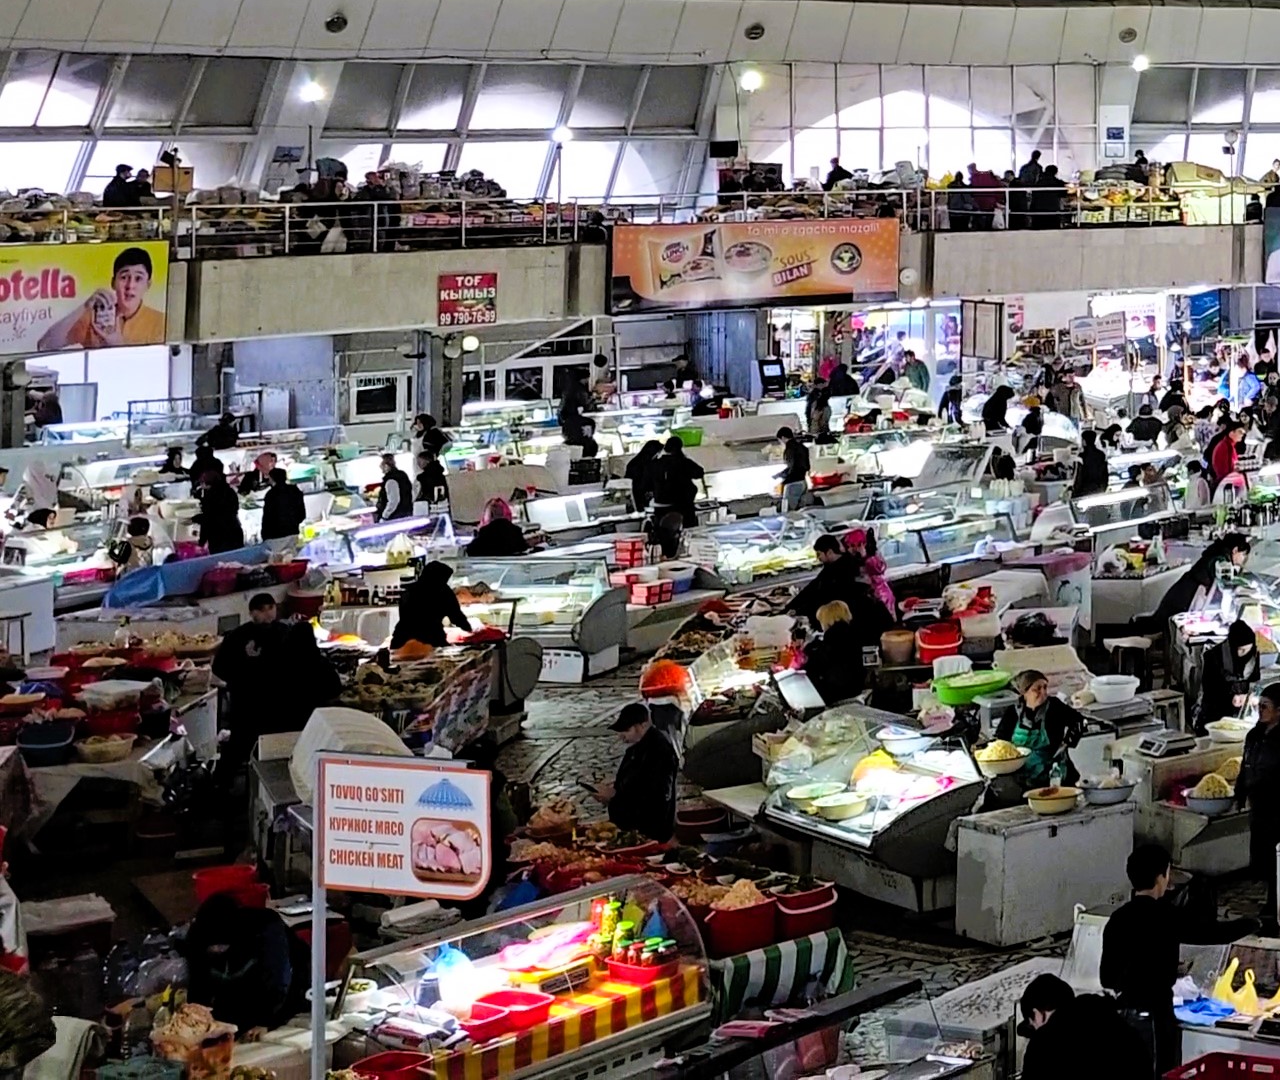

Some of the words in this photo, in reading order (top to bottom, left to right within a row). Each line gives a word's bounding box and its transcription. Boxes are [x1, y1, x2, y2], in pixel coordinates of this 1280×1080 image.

[773, 266, 809, 285] BILAN
[440, 287, 496, 301] КЫМЫЗ
[0, 306, 52, 325] ayfiyat
[440, 312, 451, 325] 99
[330, 784, 363, 803] TOVUQ
[365, 786, 404, 804] GO'SHTI
[329, 817, 373, 834] КУРИНОЕ
[375, 821, 404, 837] МЯСО
[329, 849, 375, 868] CHICKEN
[377, 853, 405, 870] MEAT
